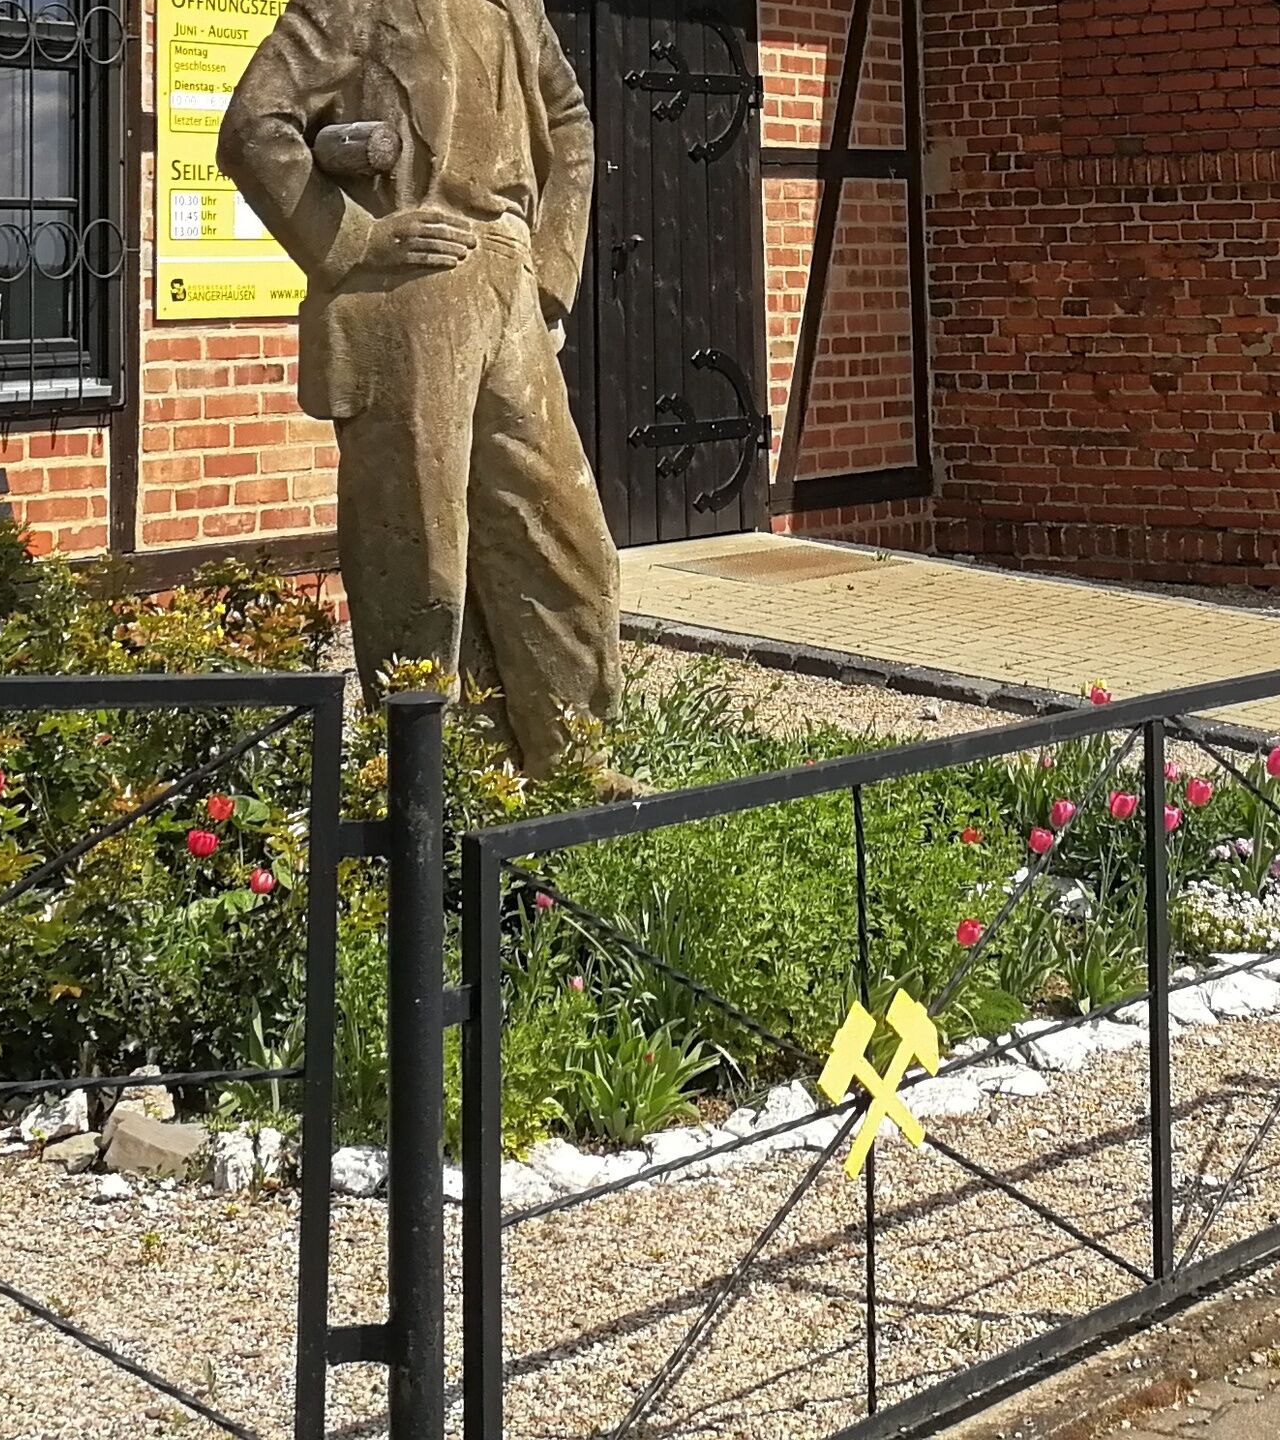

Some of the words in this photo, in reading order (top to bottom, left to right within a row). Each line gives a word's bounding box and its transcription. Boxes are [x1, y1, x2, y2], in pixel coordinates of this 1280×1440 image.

[175, 46, 208, 58] Montag
[174, 62, 226, 72] geschlossen
[175, 80, 214, 92] Dienstag
[172, 160, 231, 181] SEILFA
[201, 196, 216, 206] Uhr
[201, 210, 216, 221] Uhr
[201, 225, 216, 235] Uhr
[187, 290, 255, 302] SANGERHAUSEN
